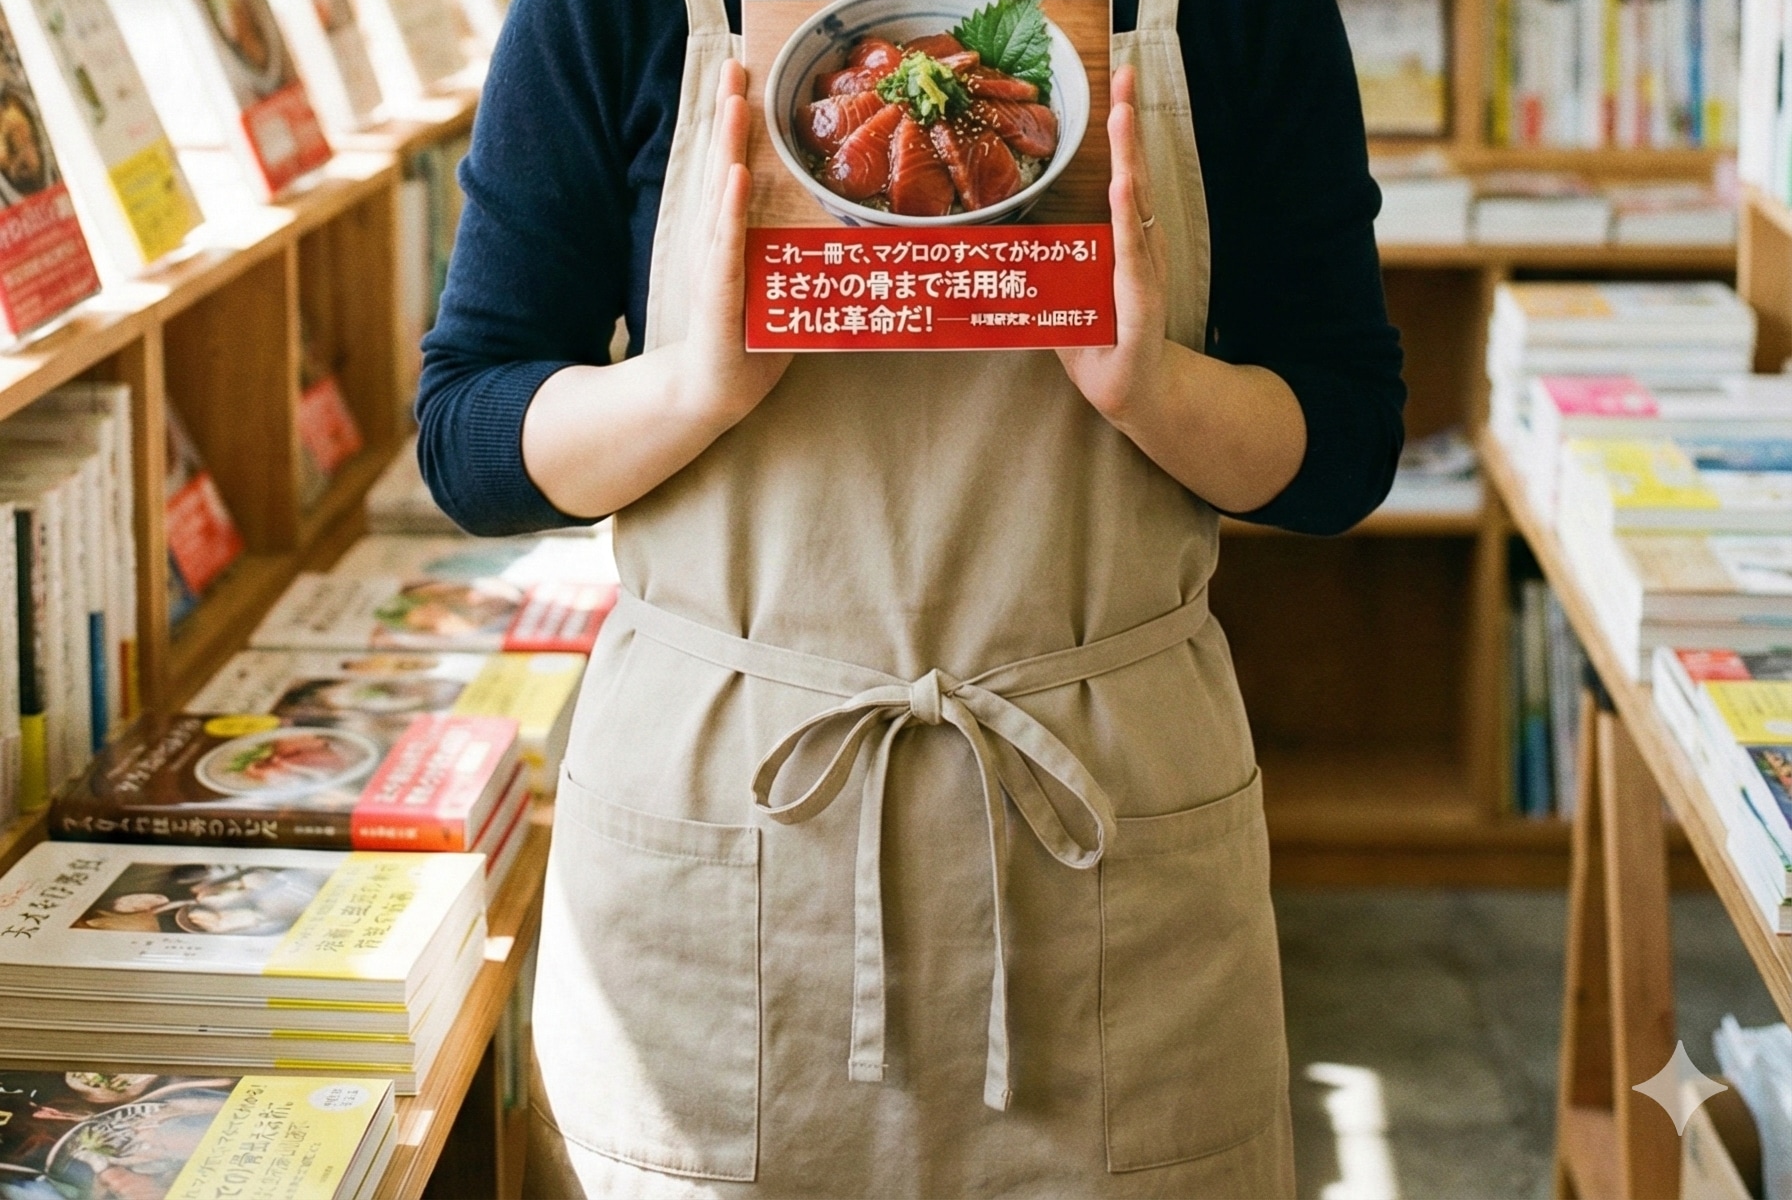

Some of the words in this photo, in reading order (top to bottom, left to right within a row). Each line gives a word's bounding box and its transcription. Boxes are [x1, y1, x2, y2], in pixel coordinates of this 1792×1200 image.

[765, 270, 1038, 301] まさかの骨まで活用術。
